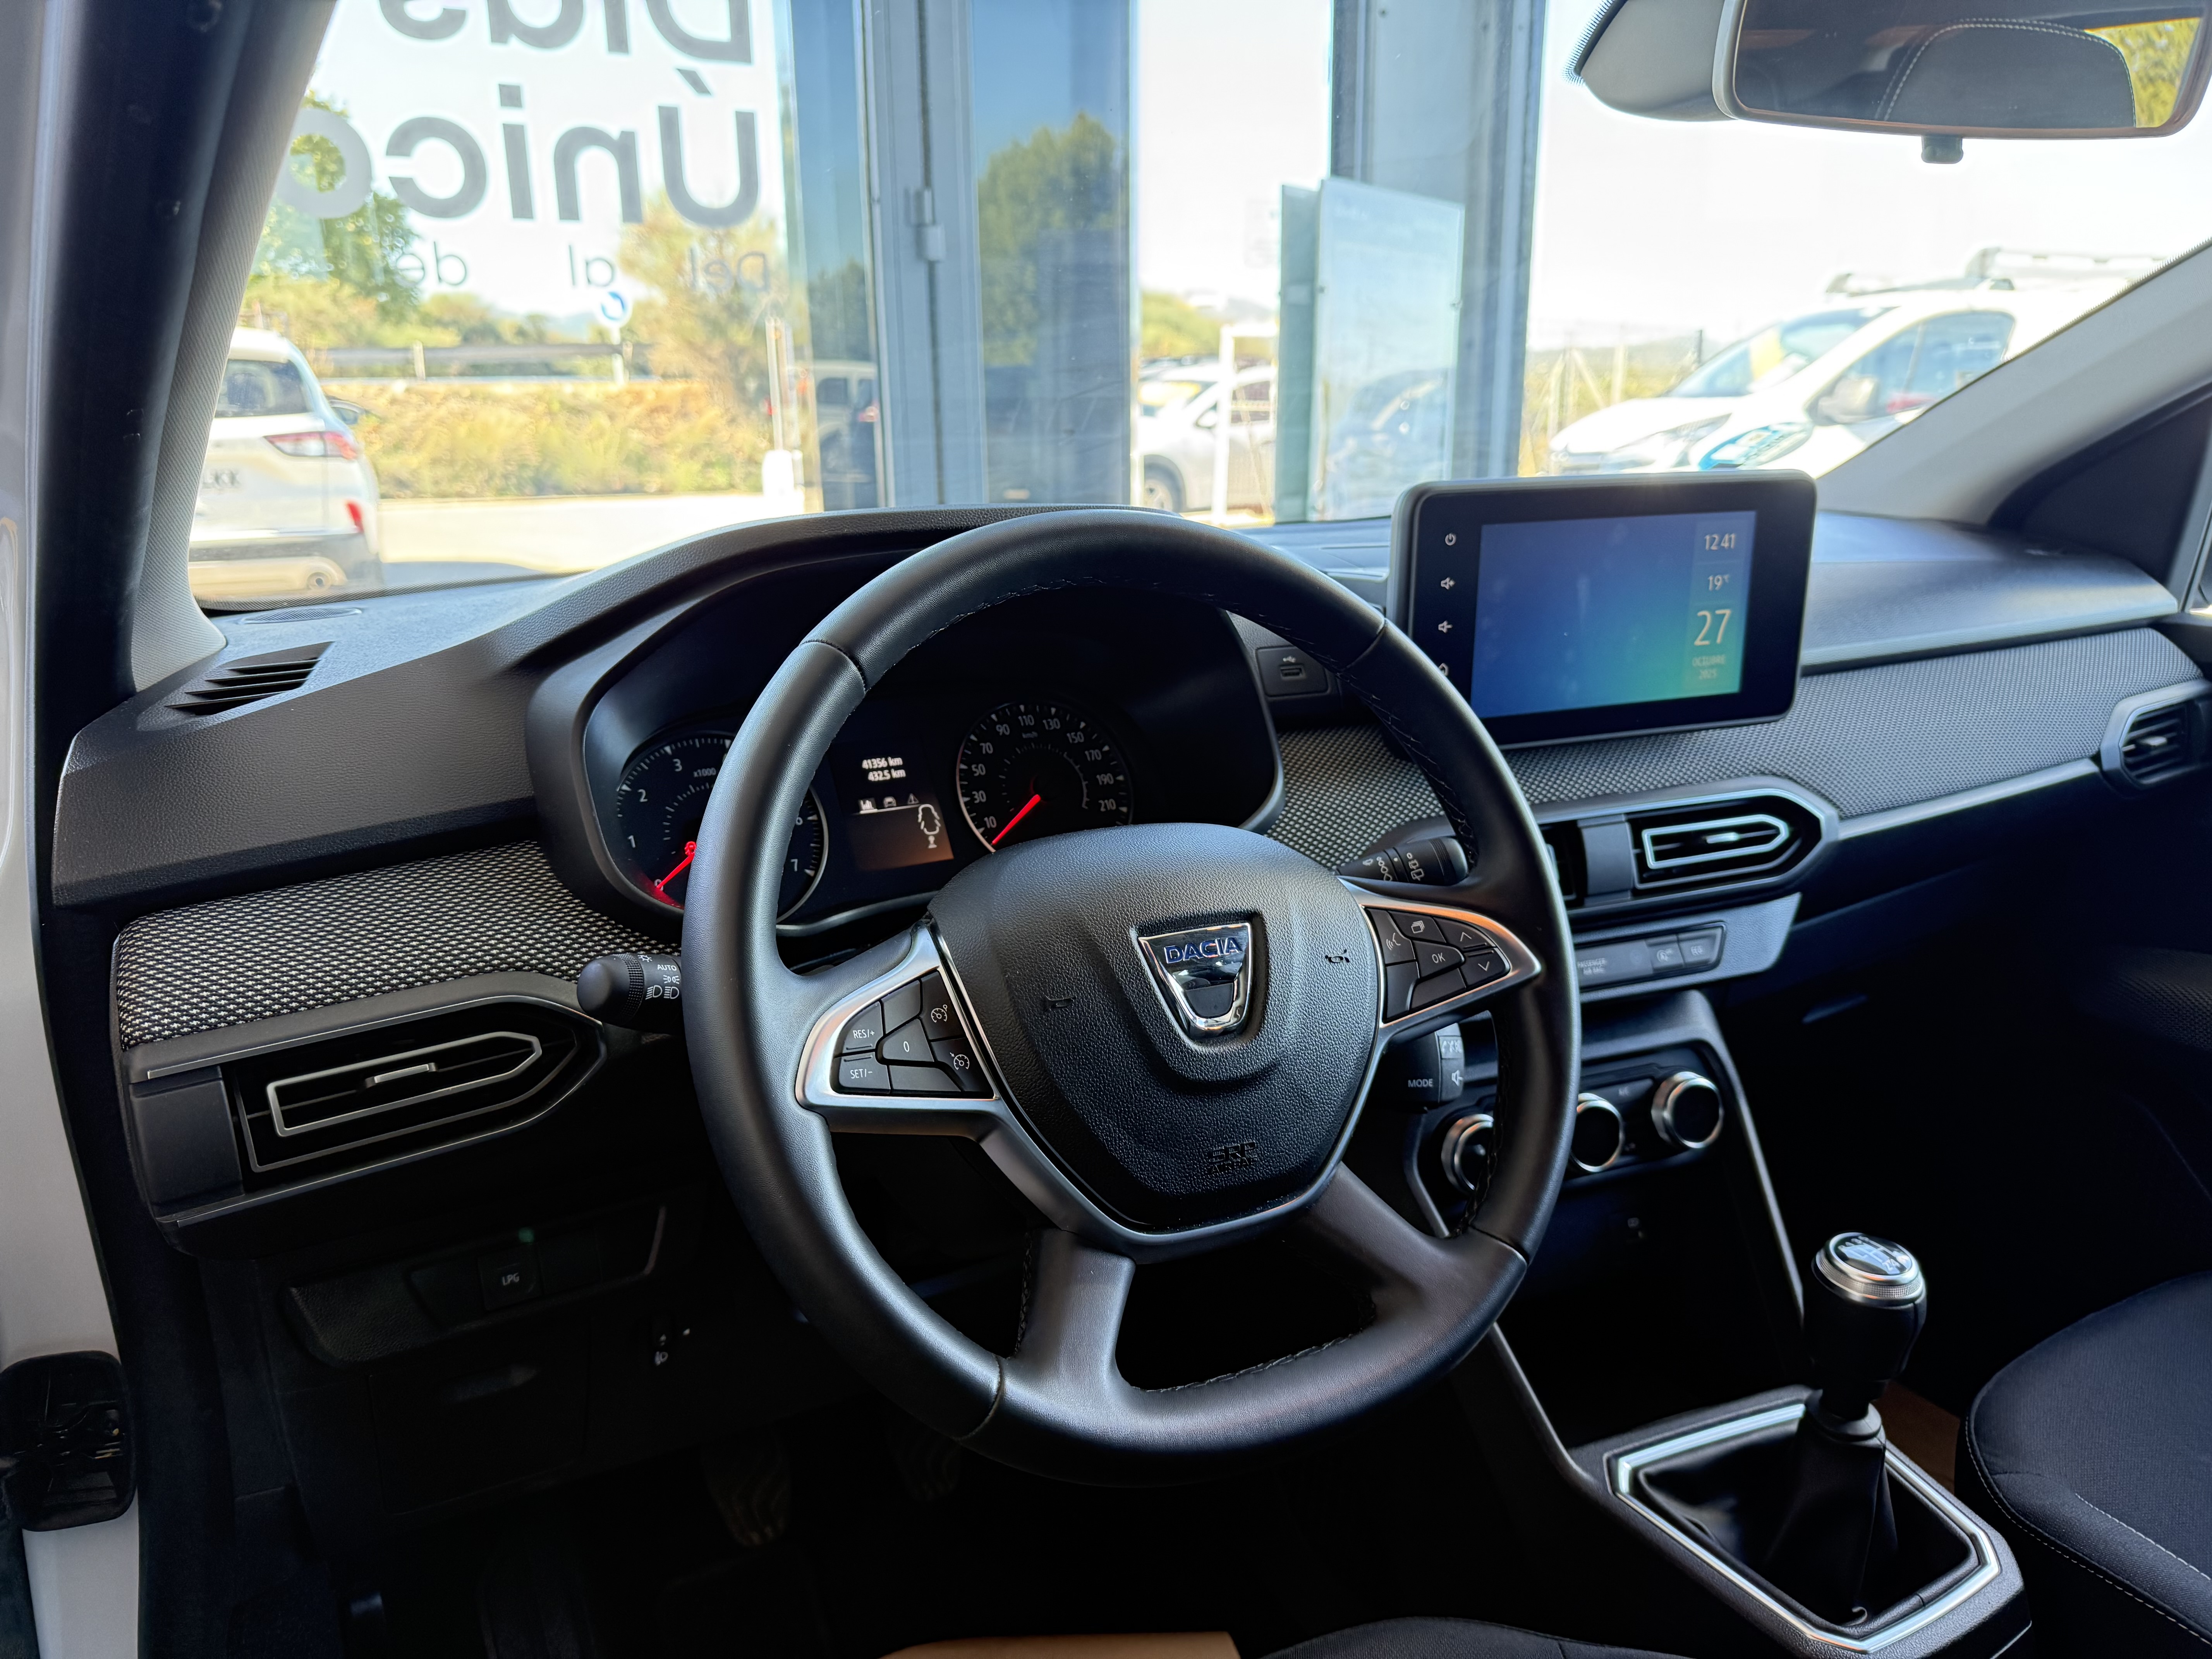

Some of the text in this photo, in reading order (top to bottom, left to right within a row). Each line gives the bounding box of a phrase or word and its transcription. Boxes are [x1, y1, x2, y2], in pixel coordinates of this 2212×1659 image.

[1694, 609, 1731, 646] 27
[1018, 714, 1034, 726] 110
[1043, 718, 1061, 730] 130
[996, 724, 1010, 735] 90
[1066, 731, 1084, 744] 150
[980, 742, 993, 754] 70
[1085, 749, 1102, 761] 170
[672, 758, 683, 771] 3
[862, 756, 903, 769] 41356 km
[891, 768, 906, 778] km
[971, 763, 986, 776] 50
[1096, 773, 1114, 785] 190
[637, 789, 648, 802] 2
[972, 790, 986, 803] 30
[1098, 799, 1116, 812] 210
[984, 816, 997, 828] 10
[627, 835, 636, 848] 1
[790, 859, 798, 872] 7
[1164, 936, 1243, 965] DACIA
[1432, 953, 1446, 964] OK
[853, 1029, 875, 1039] RES/+
[850, 1069, 873, 1079] SET/-
[1408, 1078, 1433, 1088] MODE
[502, 1272, 520, 1286] LPG
